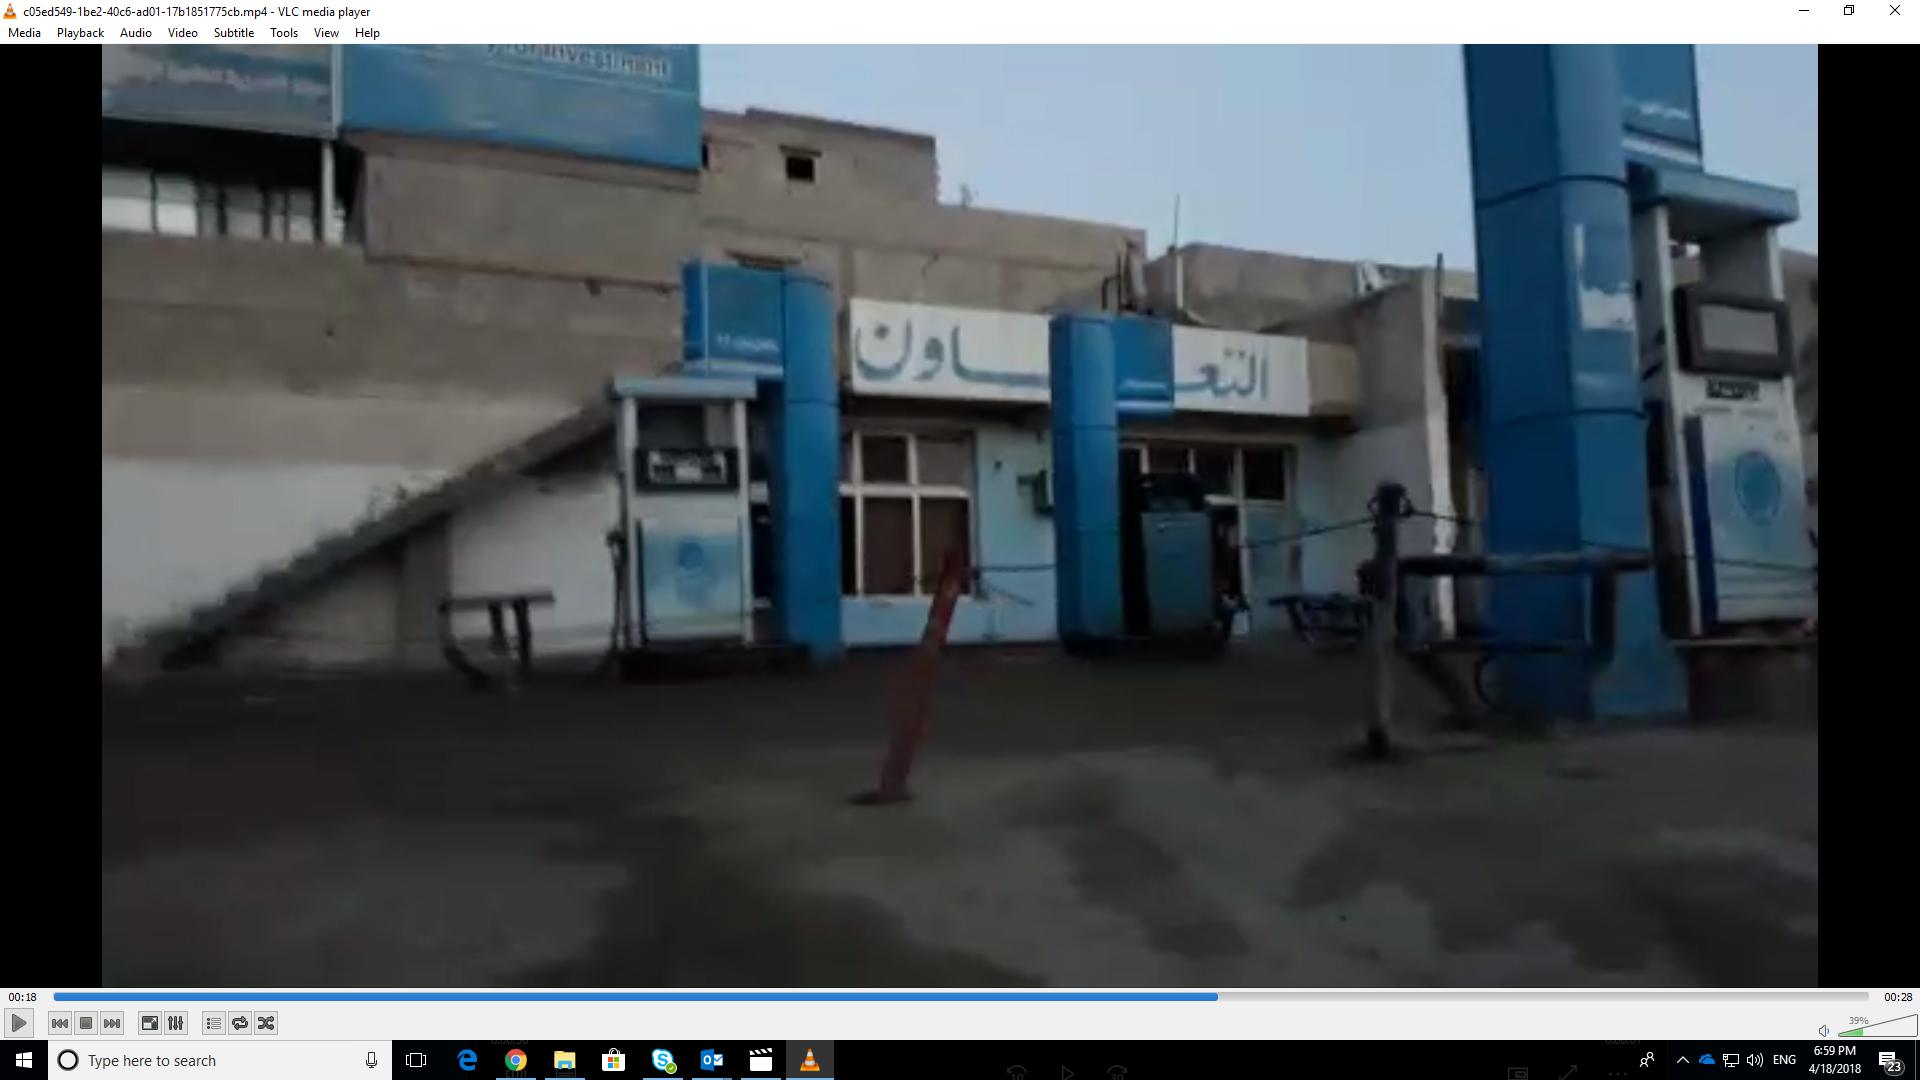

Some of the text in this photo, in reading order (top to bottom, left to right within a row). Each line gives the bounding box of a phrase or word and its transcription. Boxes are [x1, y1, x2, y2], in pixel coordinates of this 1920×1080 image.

[23, 6, 268, 20] c05ed549-1be2-40c6-ad01-17b1851775cb.mp4
[278, 6, 300, 17] VLC
[302, 6, 336, 17] media
[338, 6, 371, 20] player
[8, 27, 41, 38] Media
[57, 27, 105, 41] Playback
[119, 27, 153, 38] Audio
[167, 27, 199, 38] Video
[213, 27, 255, 38] Subtitle
[269, 27, 299, 38] Tools
[313, 27, 340, 38] View
[355, 27, 381, 41] Help
[8, 992, 37, 1002] 00:18
[1884, 992, 1913, 1002] 00:28
[1849, 1016, 1869, 1025] 39%
[1813, 1045, 1857, 1056] 6:59 PM
[88, 1054, 216, 1070] Type here to search
[1772, 1054, 1797, 1065] ENG
[1808, 1063, 1862, 1075] 4/18/2018
[1887, 1061, 1902, 1072] 23
